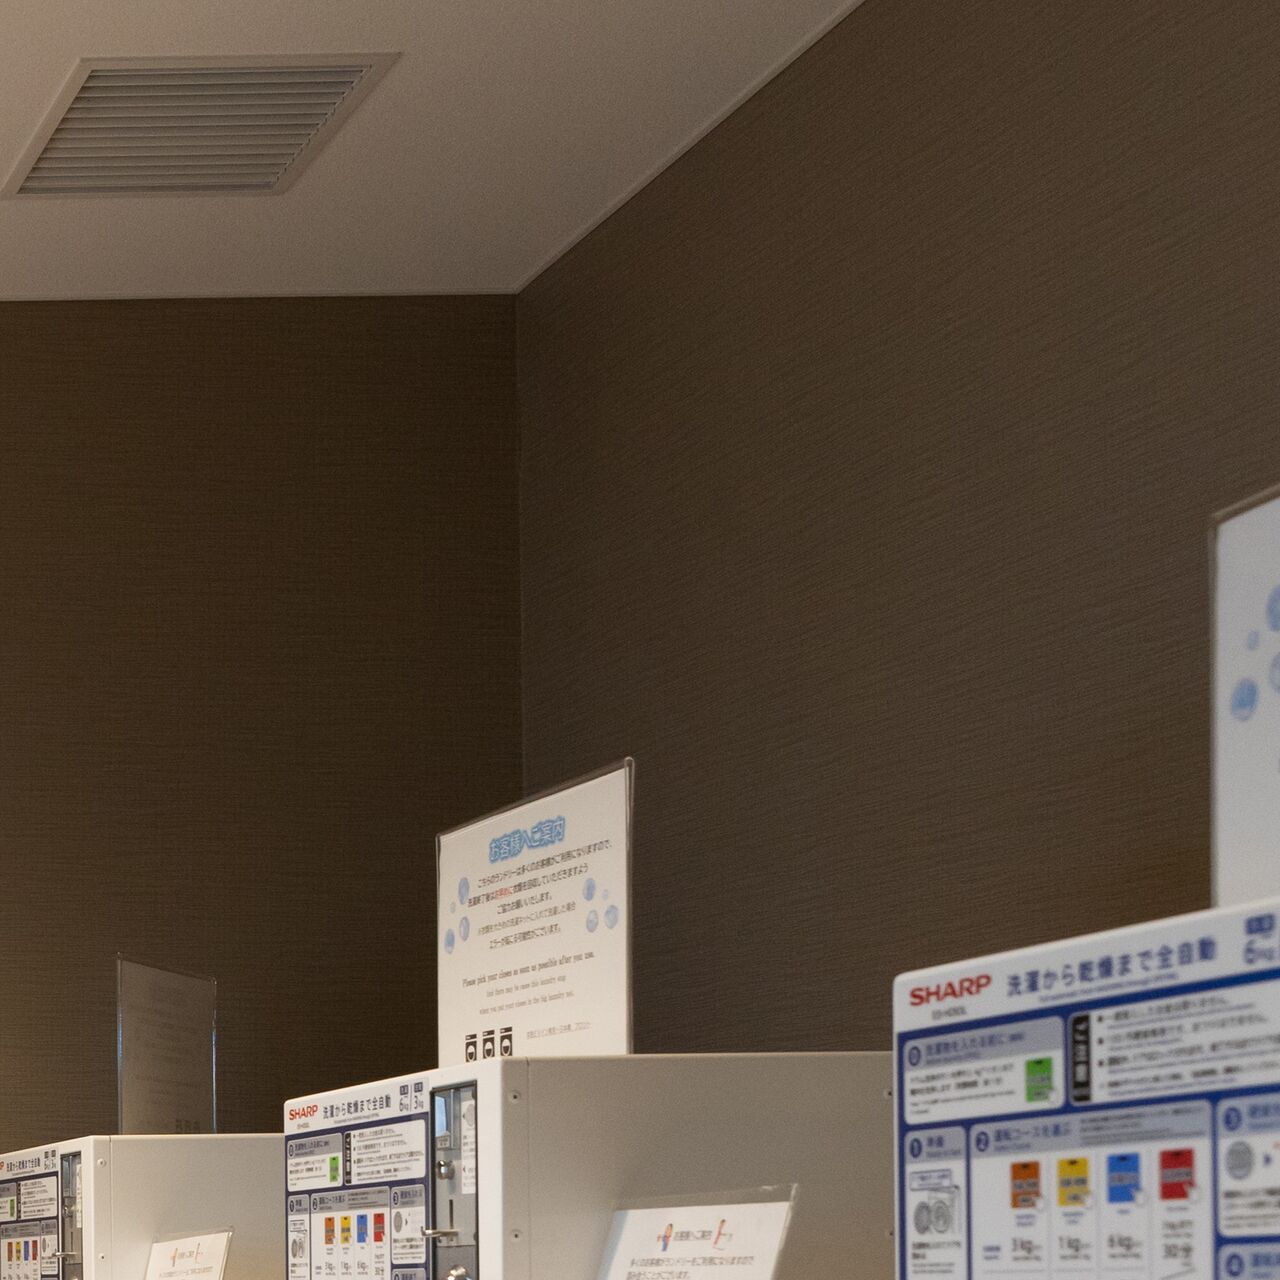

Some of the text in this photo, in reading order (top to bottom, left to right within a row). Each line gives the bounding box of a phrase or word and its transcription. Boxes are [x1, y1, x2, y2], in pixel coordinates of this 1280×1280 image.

[909, 973, 992, 1007] SHARP
[1007, 935, 1217, 997] 洗濯から乾燥まで全自動
[289, 1104, 317, 1120] SHARP
